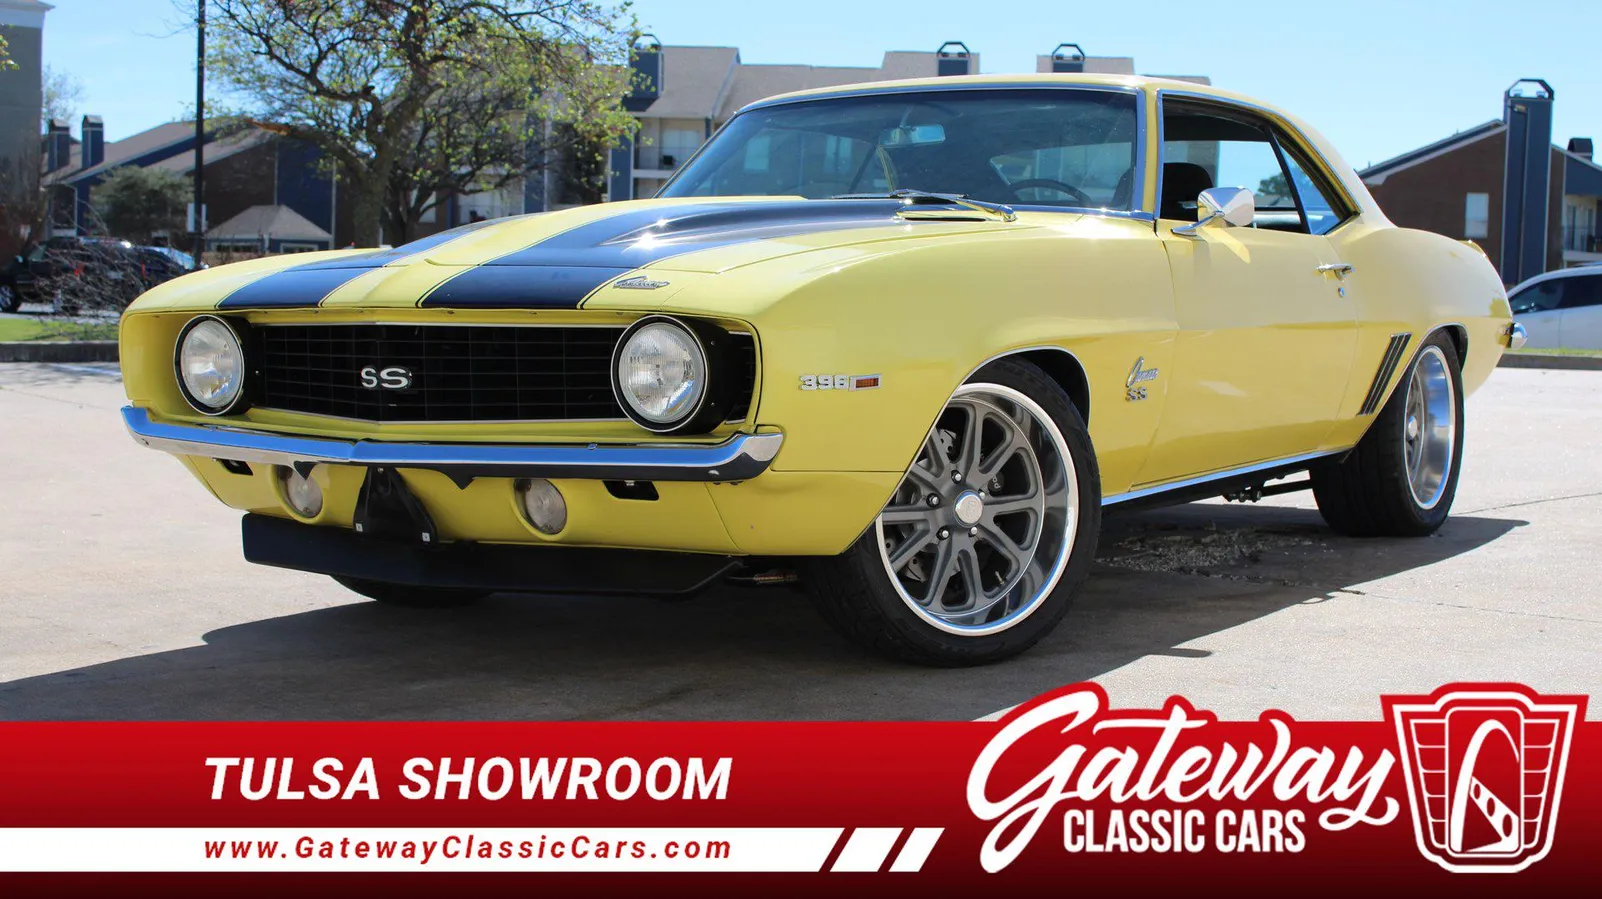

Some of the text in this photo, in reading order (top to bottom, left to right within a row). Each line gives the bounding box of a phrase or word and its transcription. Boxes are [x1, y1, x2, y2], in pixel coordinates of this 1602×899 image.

[361, 367, 408, 388] SS
[800, 374, 849, 390] 396
[1126, 387, 1147, 401] SS
